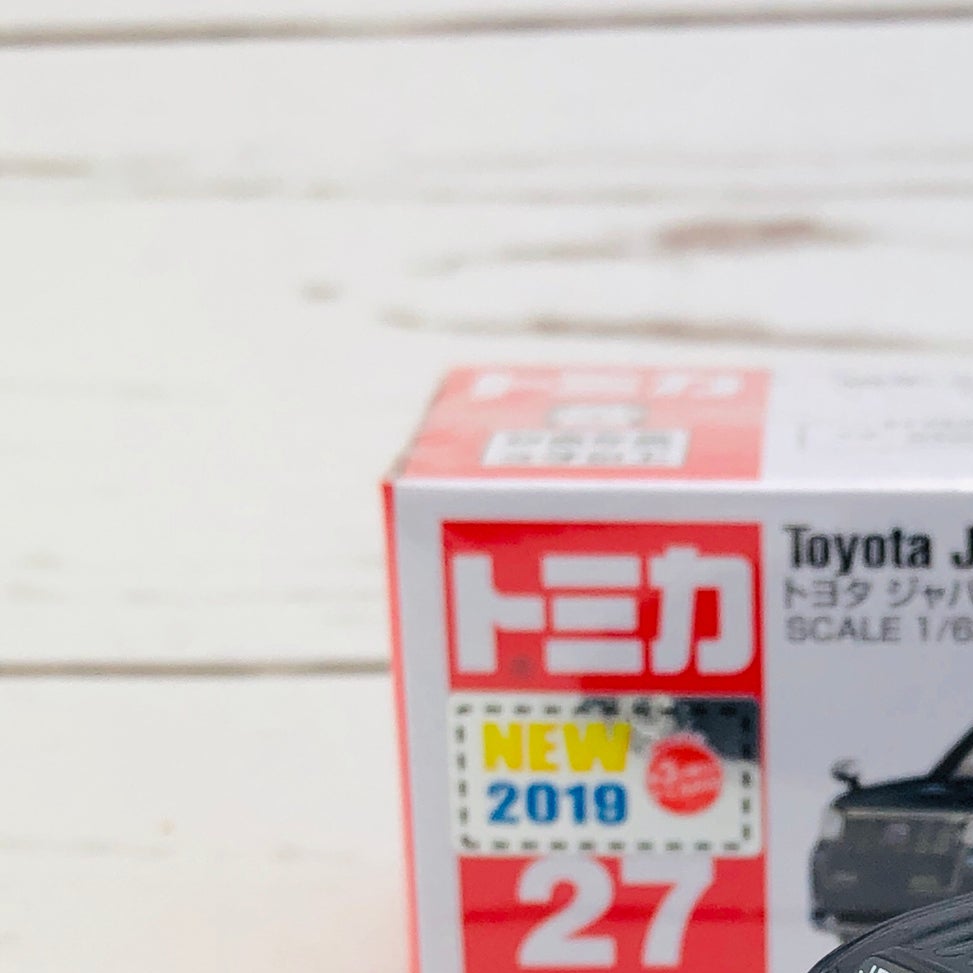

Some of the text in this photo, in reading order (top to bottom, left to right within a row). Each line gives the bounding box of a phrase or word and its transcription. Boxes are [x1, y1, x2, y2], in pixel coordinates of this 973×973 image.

[783, 524, 932, 575] Toyota
[452, 545, 755, 676] トミカ
[784, 577, 872, 609] トヨタ
[785, 615, 902, 643] SCALE
[482, 722, 632, 772] NEW
[486, 781, 629, 826] 2019
[516, 854, 716, 968] 27
